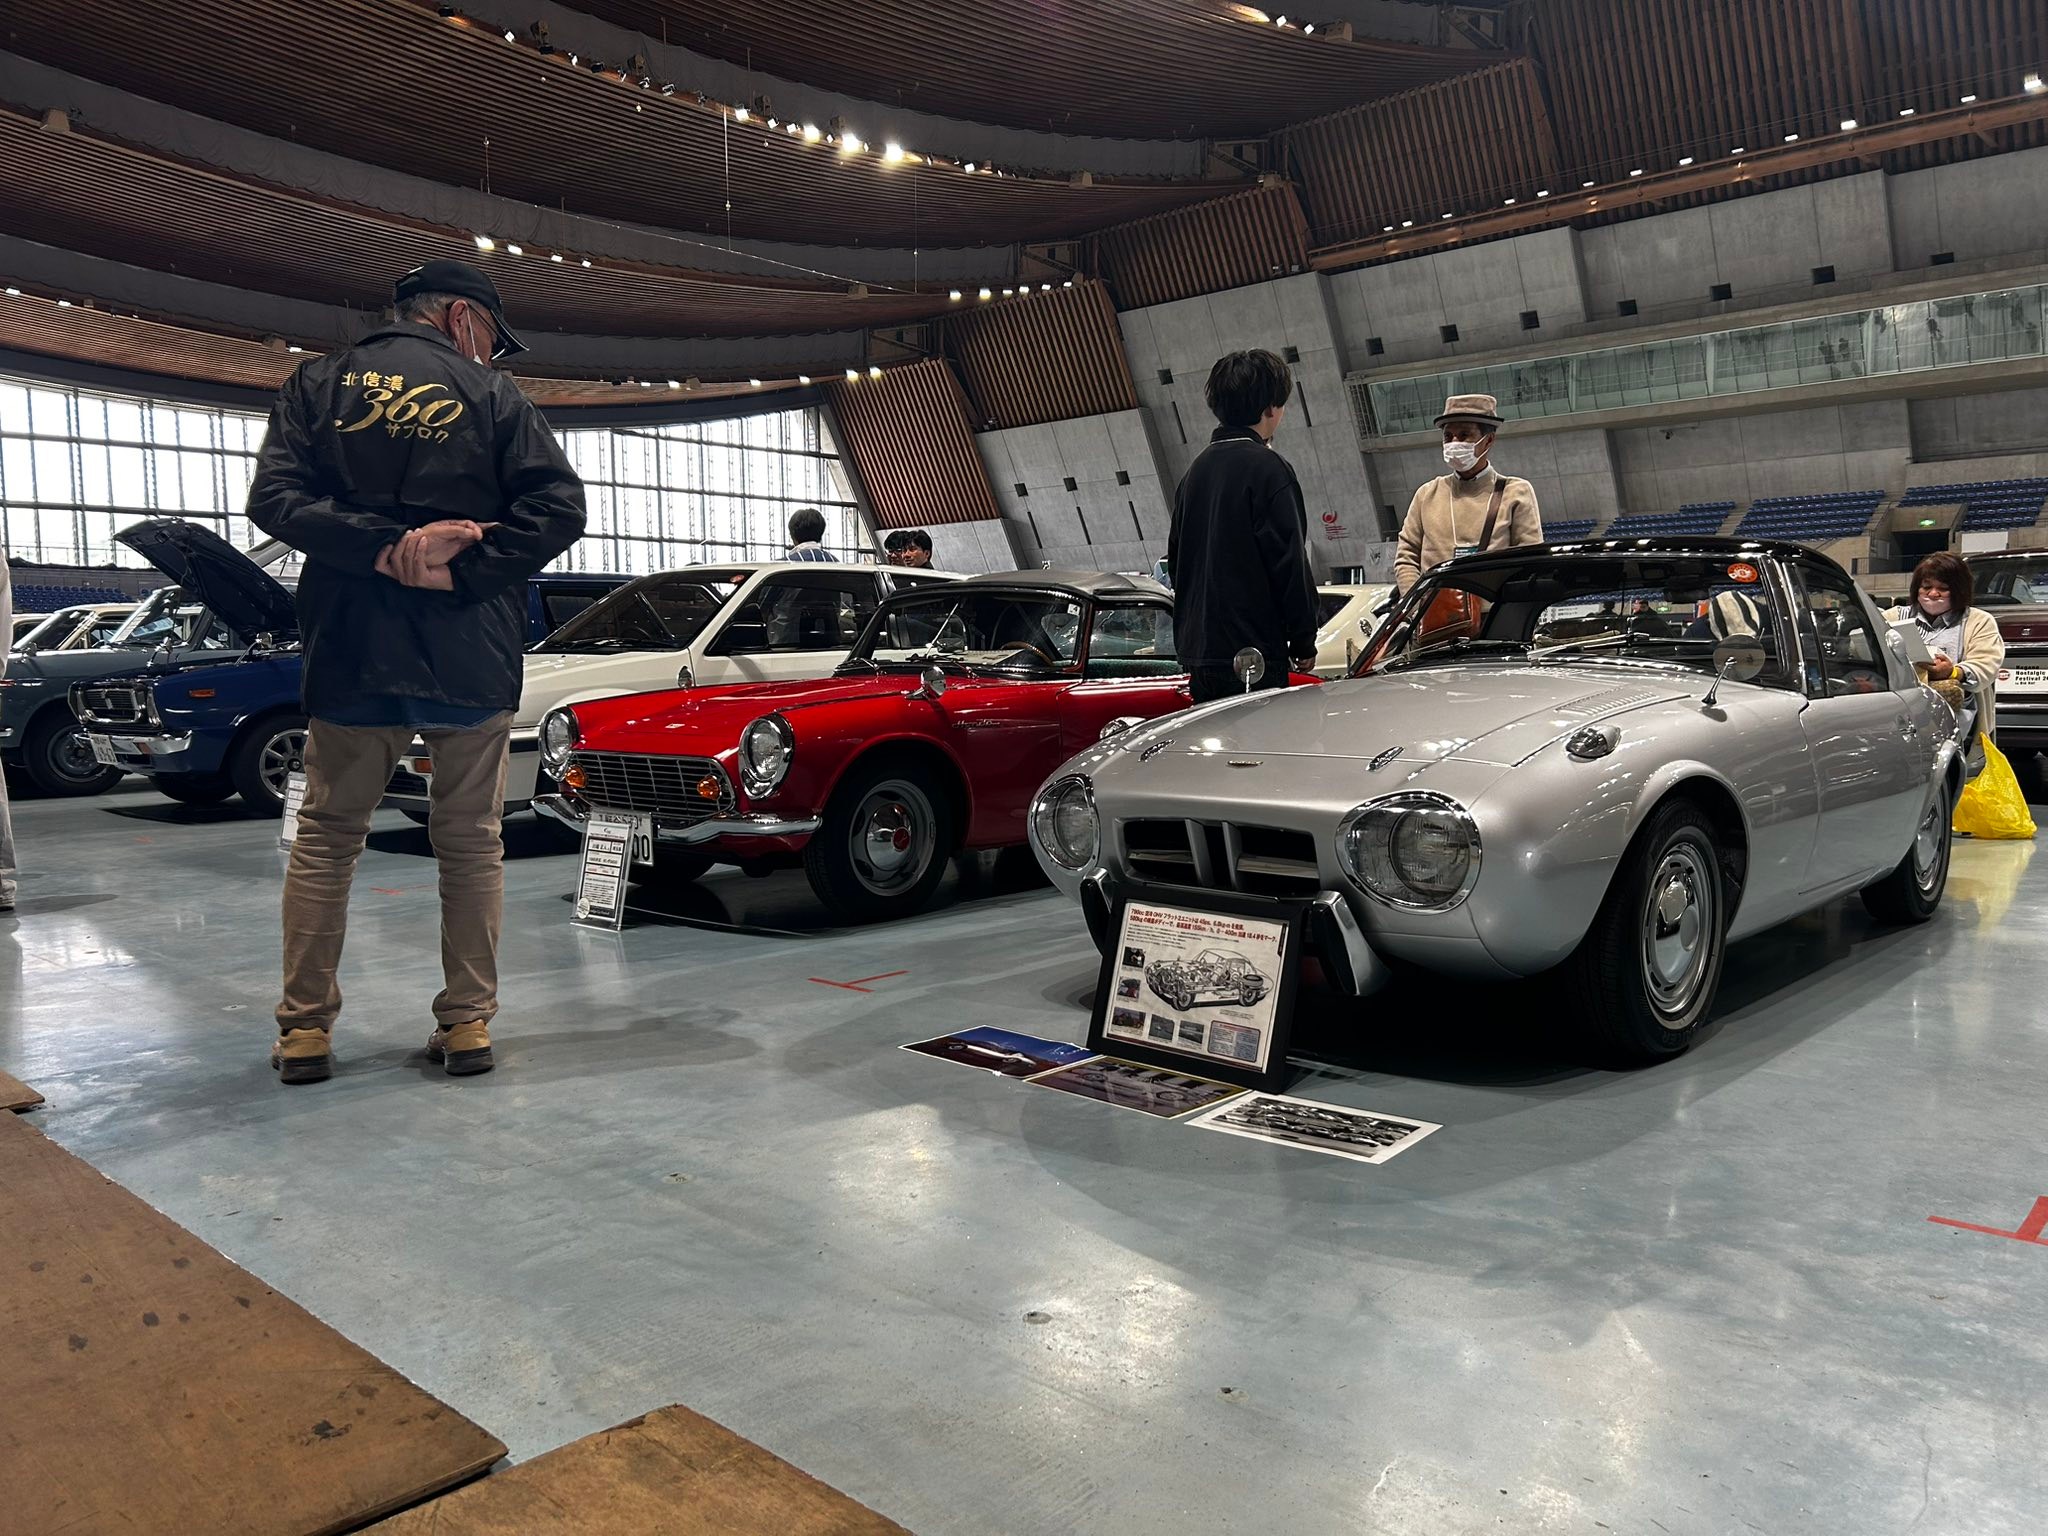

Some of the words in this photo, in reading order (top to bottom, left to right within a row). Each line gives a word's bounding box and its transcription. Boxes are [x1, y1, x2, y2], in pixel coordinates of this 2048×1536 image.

[341, 370, 405, 392] 北信濃
[334, 383, 464, 432] 360
[385, 422, 450, 444] サブロク
